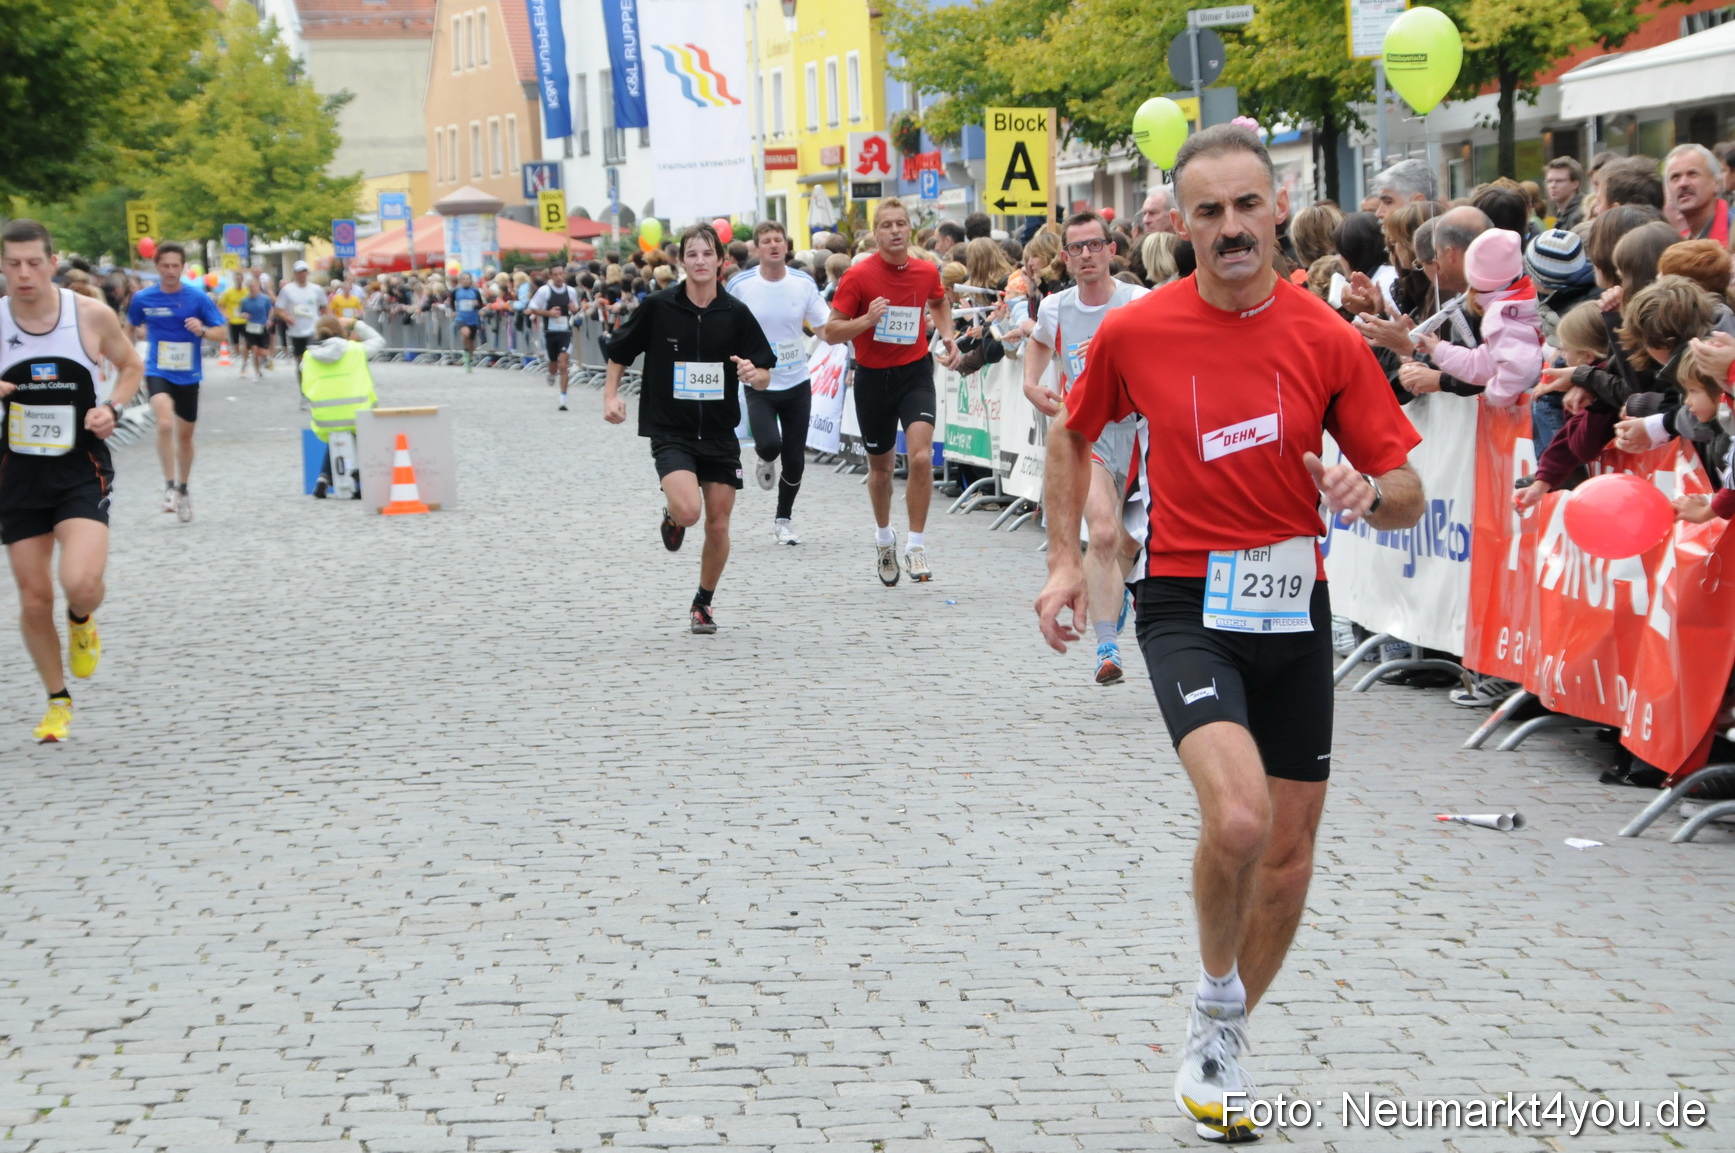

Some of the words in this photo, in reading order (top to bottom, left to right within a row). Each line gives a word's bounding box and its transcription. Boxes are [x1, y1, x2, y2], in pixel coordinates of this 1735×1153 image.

[1200, 12, 1223, 22] Ulmer
[1225, 9, 1250, 19] Gasse
[994, 112, 1048, 132] Block
[1001, 141, 1041, 191] A
[546, 203, 561, 223] B
[135, 214, 150, 234] B
[335, 245, 354, 254] TAXI
[889, 321, 916, 332] 2317
[780, 350, 800, 361] 3087
[689, 374, 720, 384] 3484
[15, 382, 47, 391] VR-Bank
[47, 381, 76, 390] Coburg
[24, 410, 55, 420] Marcus
[31, 425, 61, 438] 279
[1223, 427, 1257, 447] DEHN
[1243, 545, 1272, 562] Karl
[1214, 569, 1222, 582] A
[1241, 573, 1303, 598] 2319
[1272, 619, 1309, 627] PFLEIDERER
